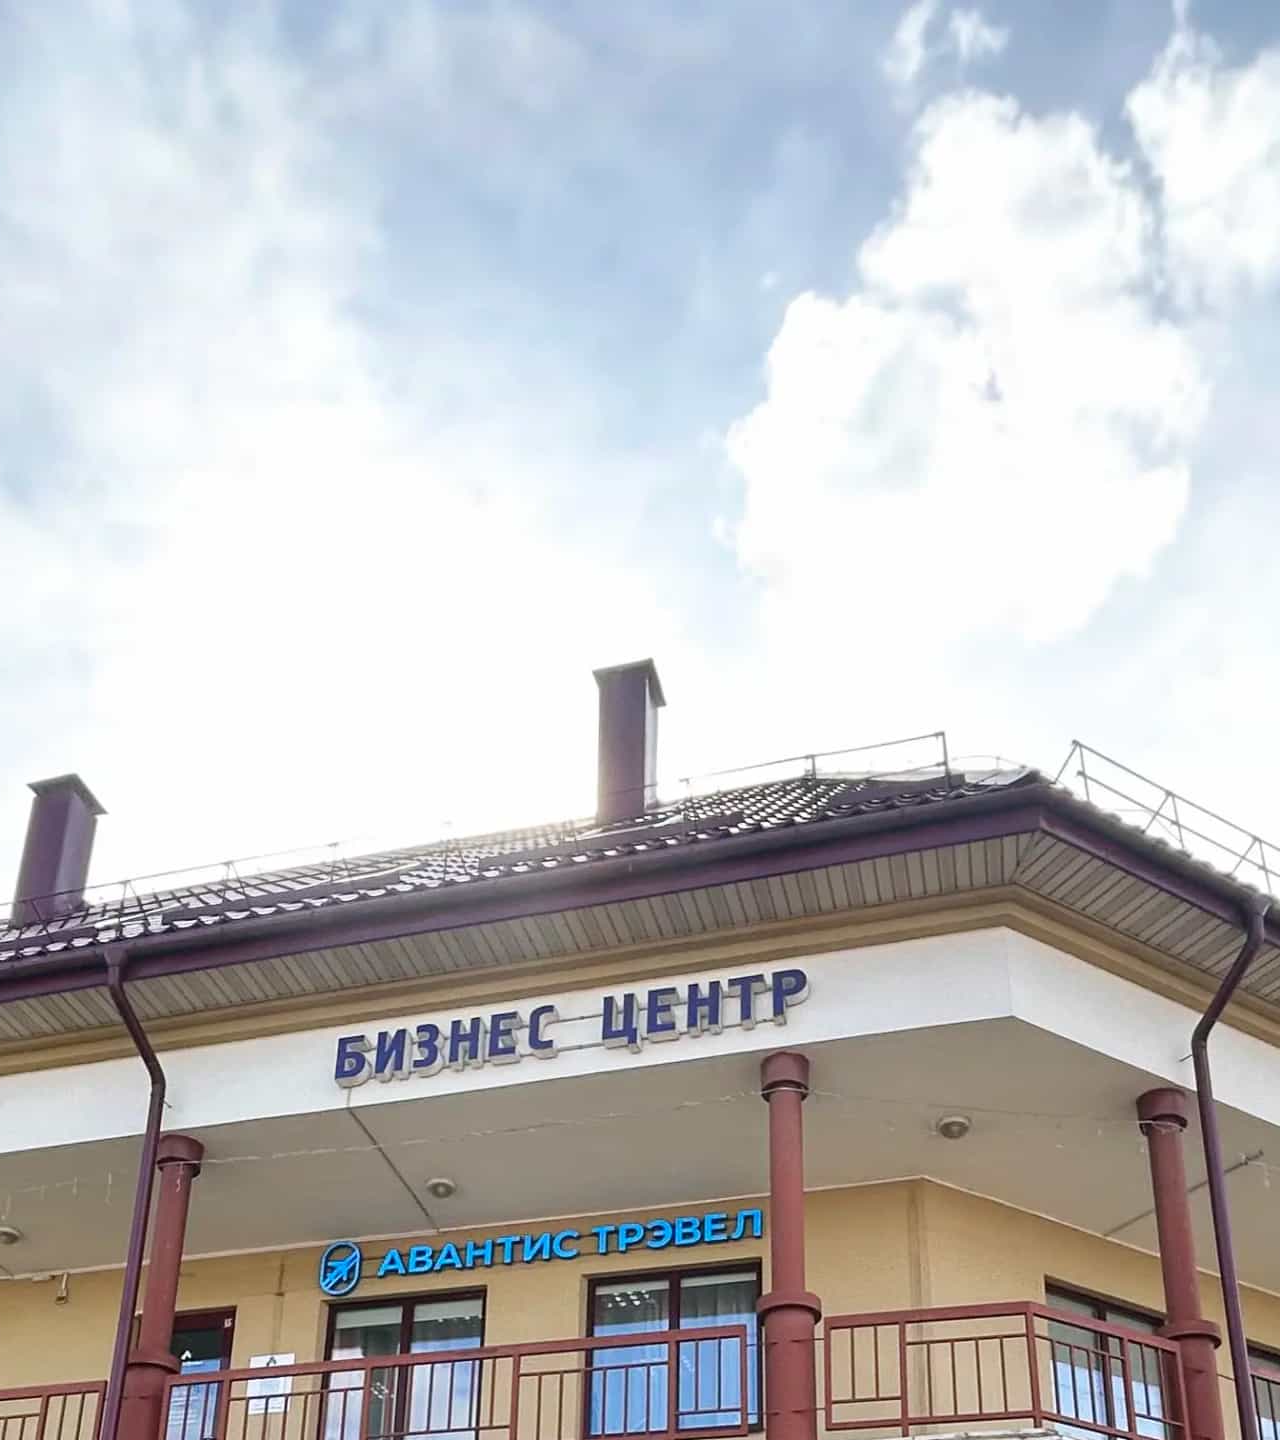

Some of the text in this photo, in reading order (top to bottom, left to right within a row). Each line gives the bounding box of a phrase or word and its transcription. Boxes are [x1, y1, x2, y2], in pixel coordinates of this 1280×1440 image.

[333, 968, 811, 1089] БИЗНЕС ЦЕНТР
[376, 1207, 765, 1279] АВАНТИС ТРЭВЕЛ
